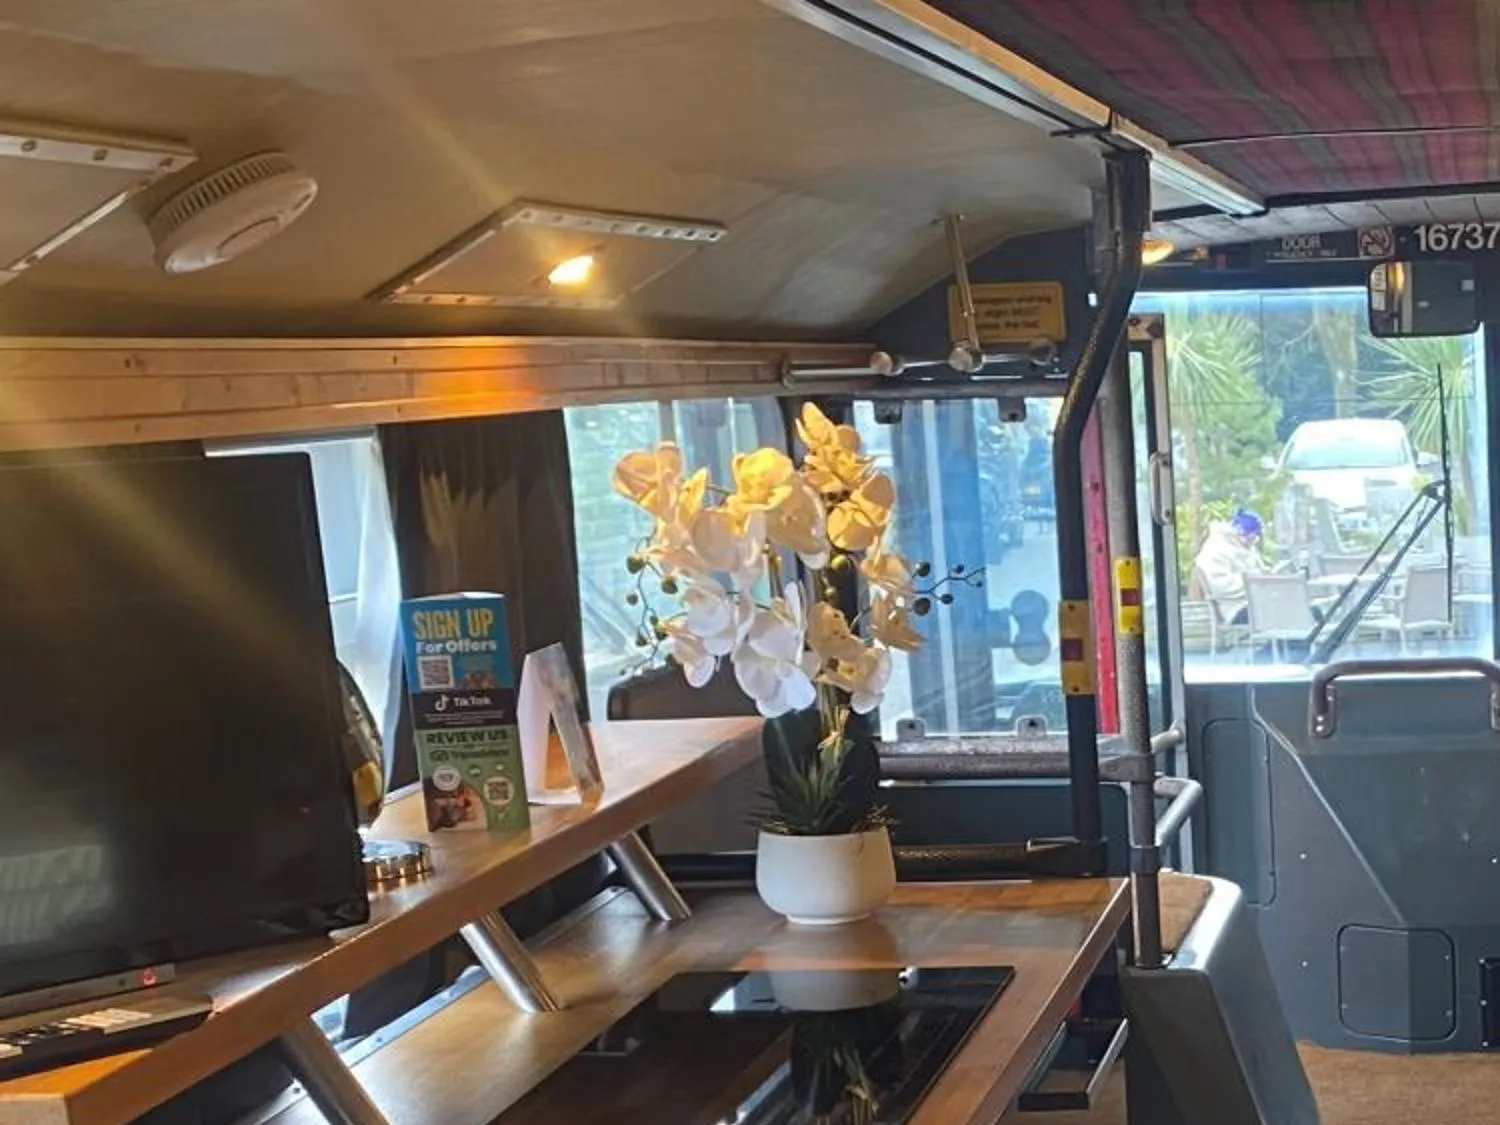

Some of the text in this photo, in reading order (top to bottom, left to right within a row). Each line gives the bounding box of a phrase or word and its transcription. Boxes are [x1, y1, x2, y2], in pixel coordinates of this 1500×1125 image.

[1414, 222, 1500, 251] 16737
[414, 607, 494, 639] SIGN UP
[416, 639, 497, 653] For Offers
[426, 731, 486, 744] REVIEW
